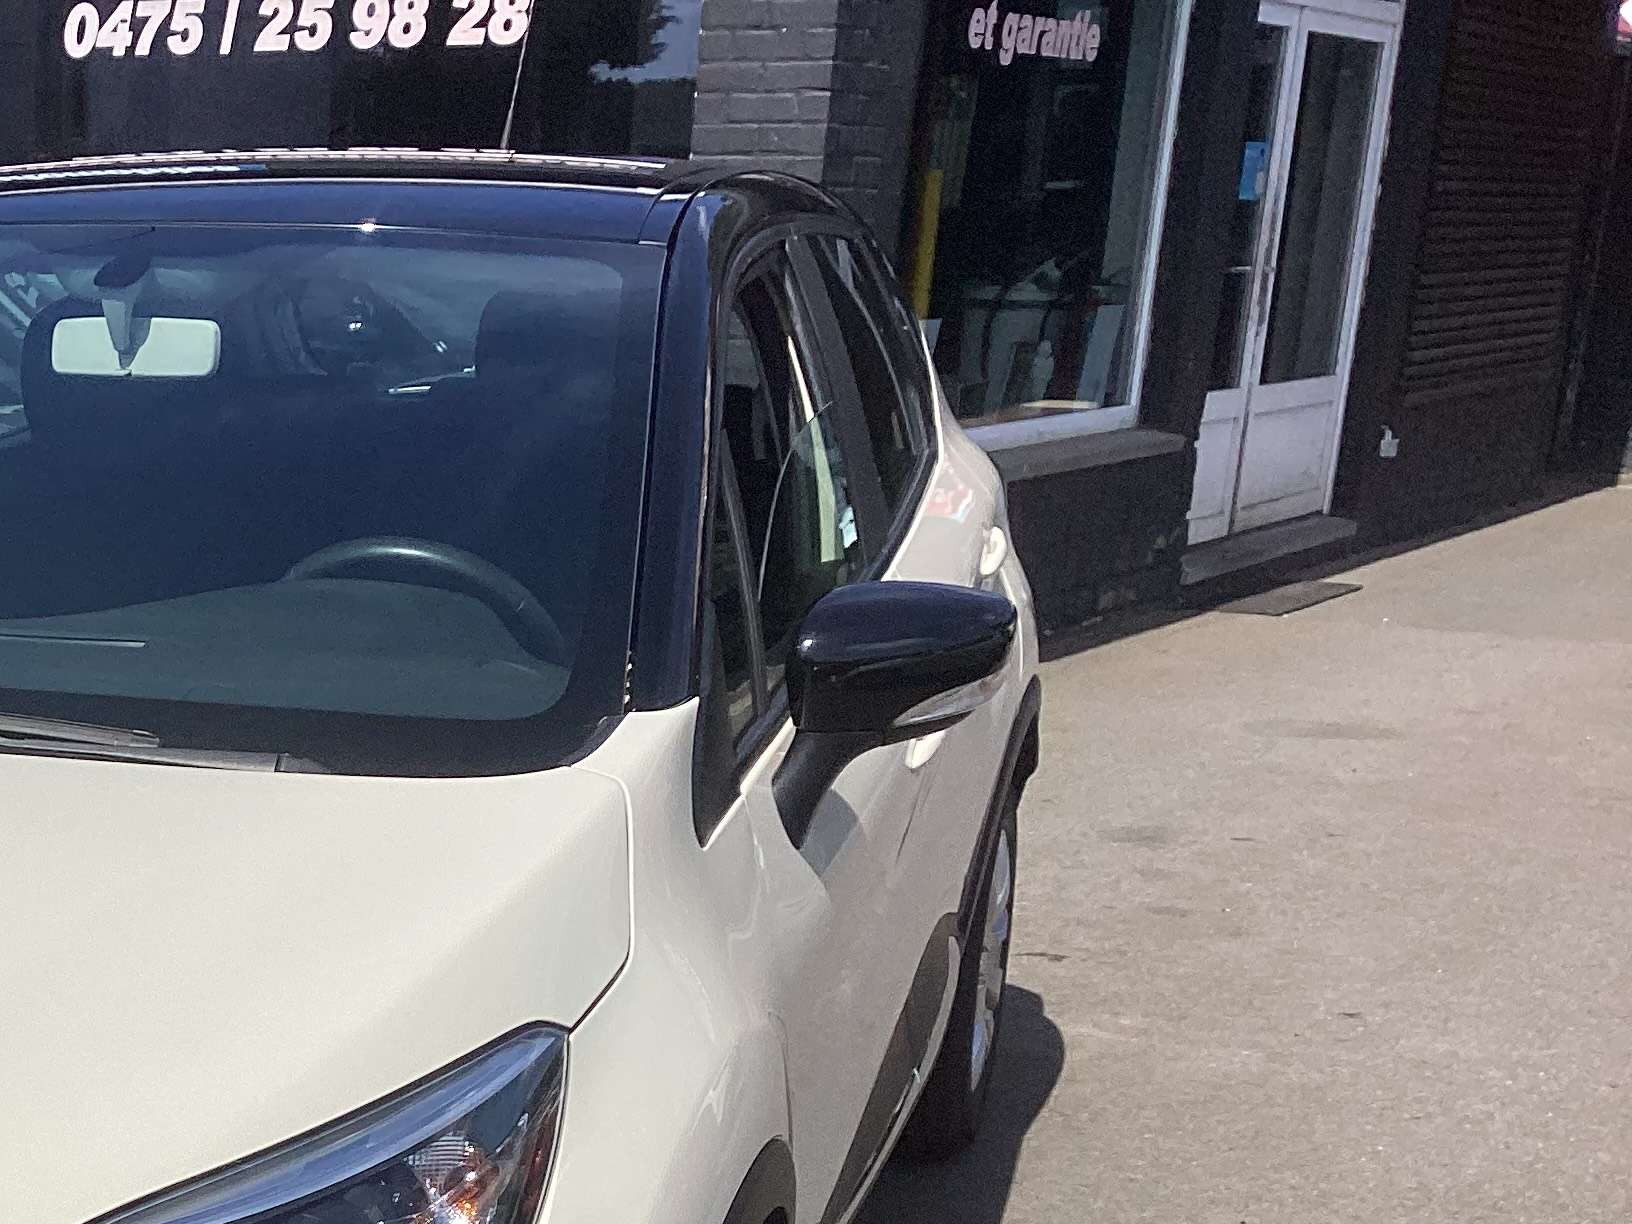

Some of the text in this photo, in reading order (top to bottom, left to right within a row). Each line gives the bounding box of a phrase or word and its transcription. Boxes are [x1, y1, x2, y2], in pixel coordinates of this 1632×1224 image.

[63, 0, 204, 58] 0475
[253, 0, 334, 51] 25
[349, 0, 429, 50] 98
[445, 0, 530, 46] 28
[968, 0, 1101, 66] et garantie
